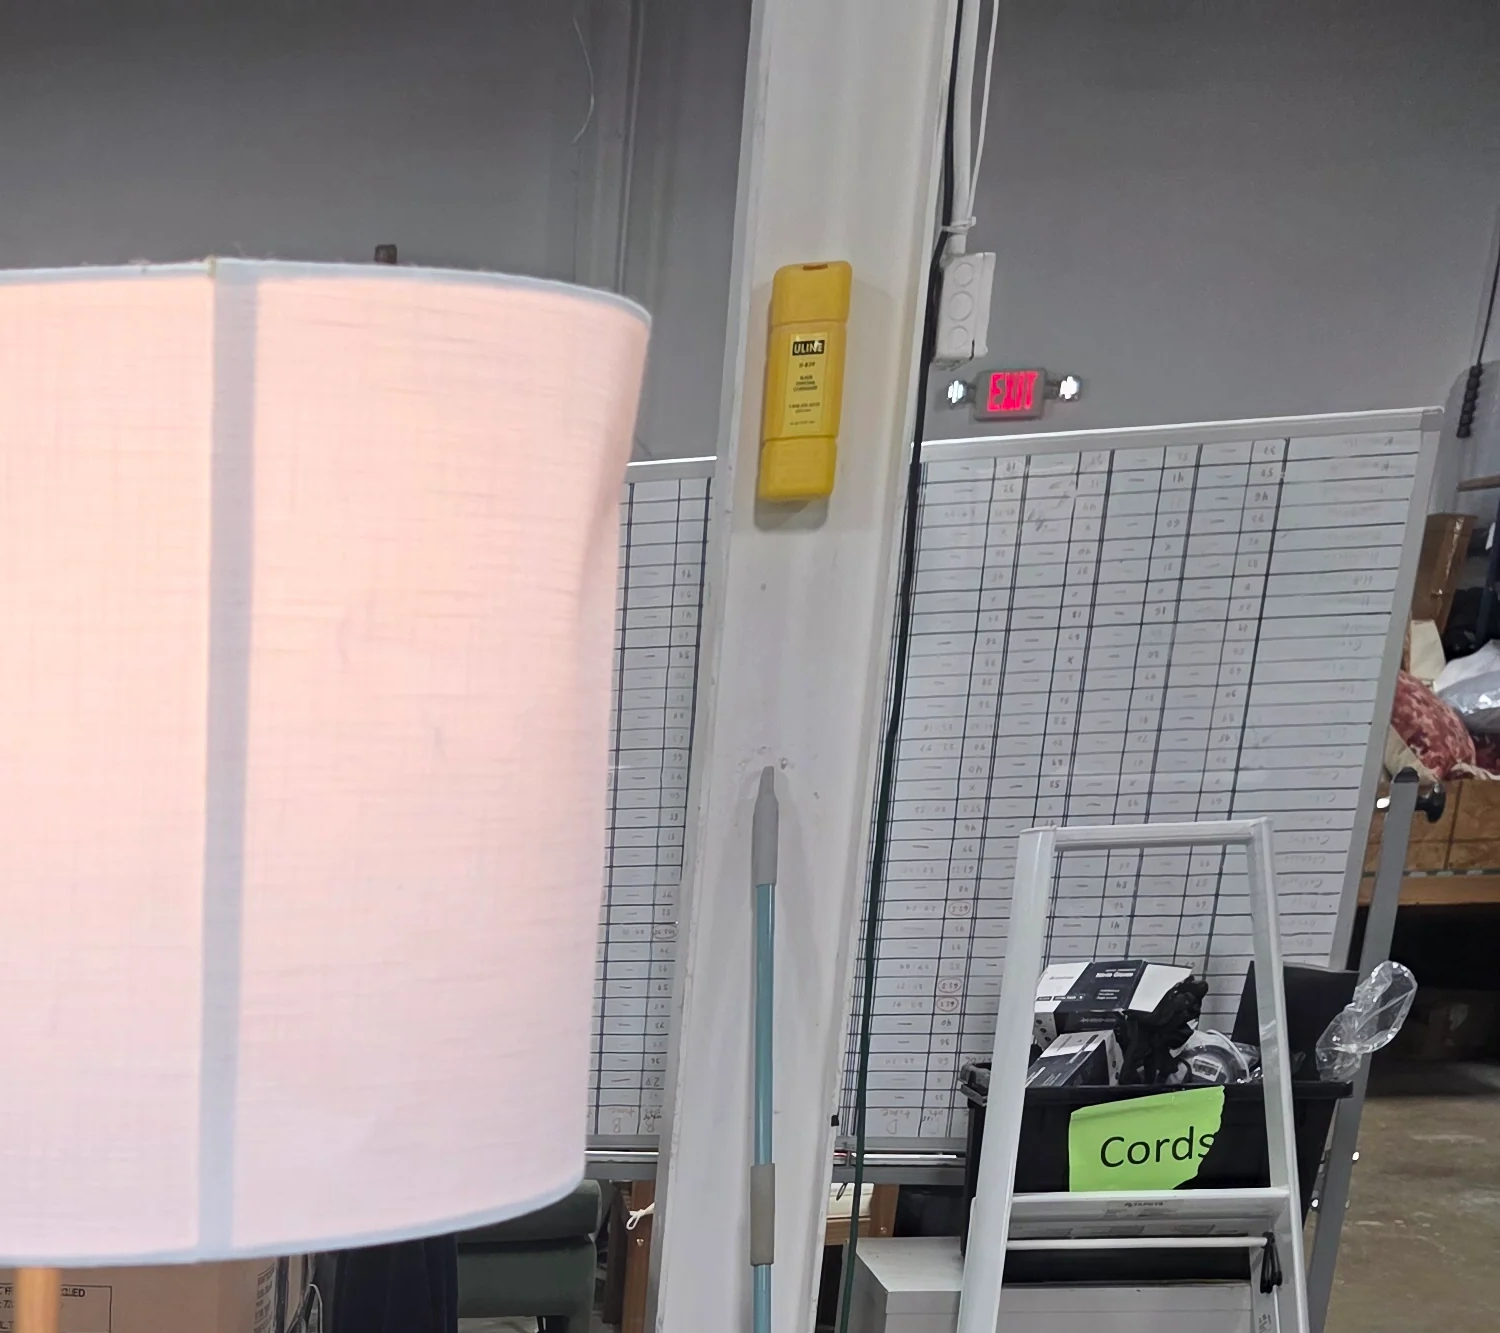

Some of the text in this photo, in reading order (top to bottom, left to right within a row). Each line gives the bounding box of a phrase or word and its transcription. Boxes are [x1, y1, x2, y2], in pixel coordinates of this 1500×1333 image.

[793, 342, 824, 355] ULINE
[987, 371, 1039, 412] EXIT
[1101, 1126, 1215, 1167] Cords
